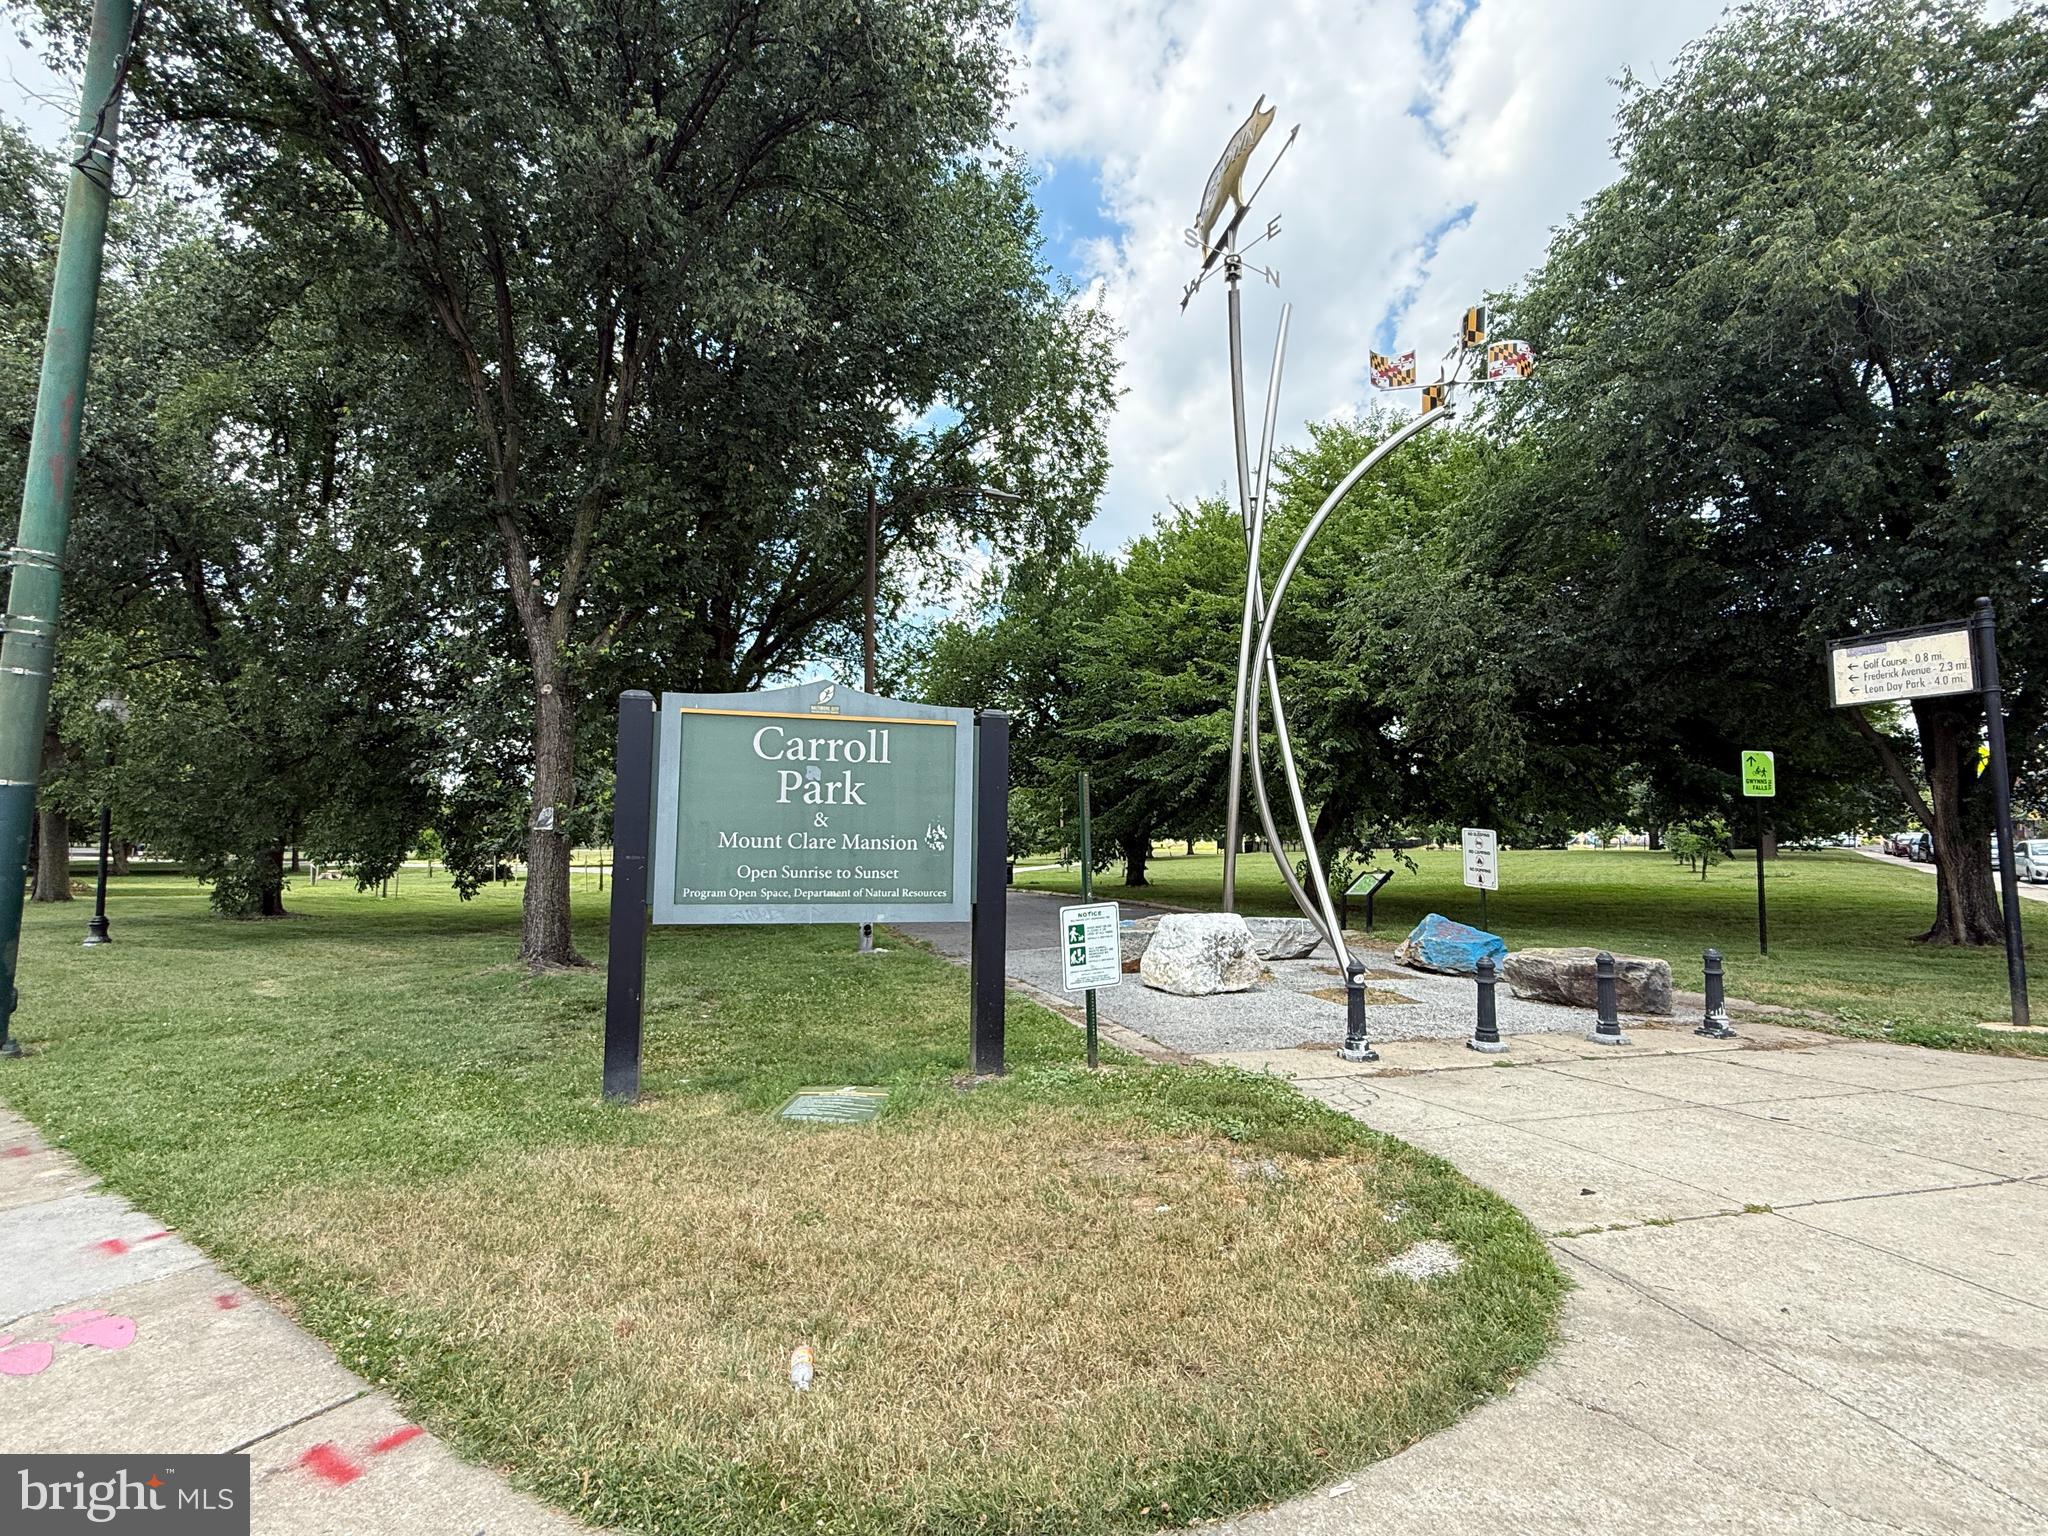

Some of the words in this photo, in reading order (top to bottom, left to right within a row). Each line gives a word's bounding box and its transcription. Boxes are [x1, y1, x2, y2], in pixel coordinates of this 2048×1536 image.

[1863, 658, 1879, 670] Golf
[1881, 658, 1908, 668] Course
[1863, 669, 1899, 681] Frederick
[1901, 667, 1931, 677] Avenue
[1939, 662, 1953, 672] 2.3
[1864, 684, 1884, 694] Leon
[1886, 682, 1903, 692] Day
[1906, 678, 1926, 689] Park
[752, 726, 892, 764] Carroll
[776, 770, 867, 806] Park
[813, 812, 829, 828] &
[717, 831, 783, 850] Mount
[787, 832, 837, 850] Clare
[841, 833, 919, 851] Mansion
[737, 864, 778, 882] Open
[781, 865, 833, 879] Sunrise
[837, 869, 851, 879] to
[855, 866, 900, 879] Sunset
[682, 887, 727, 900] Program
[729, 888, 757, 900] Open
[760, 887, 792, 900] Space,
[793, 888, 851, 900] Department
[853, 888, 864, 897] of
[865, 888, 900, 898] Natural
[902, 888, 947, 898] Resources
[1077, 910, 1102, 918] NOTICE
